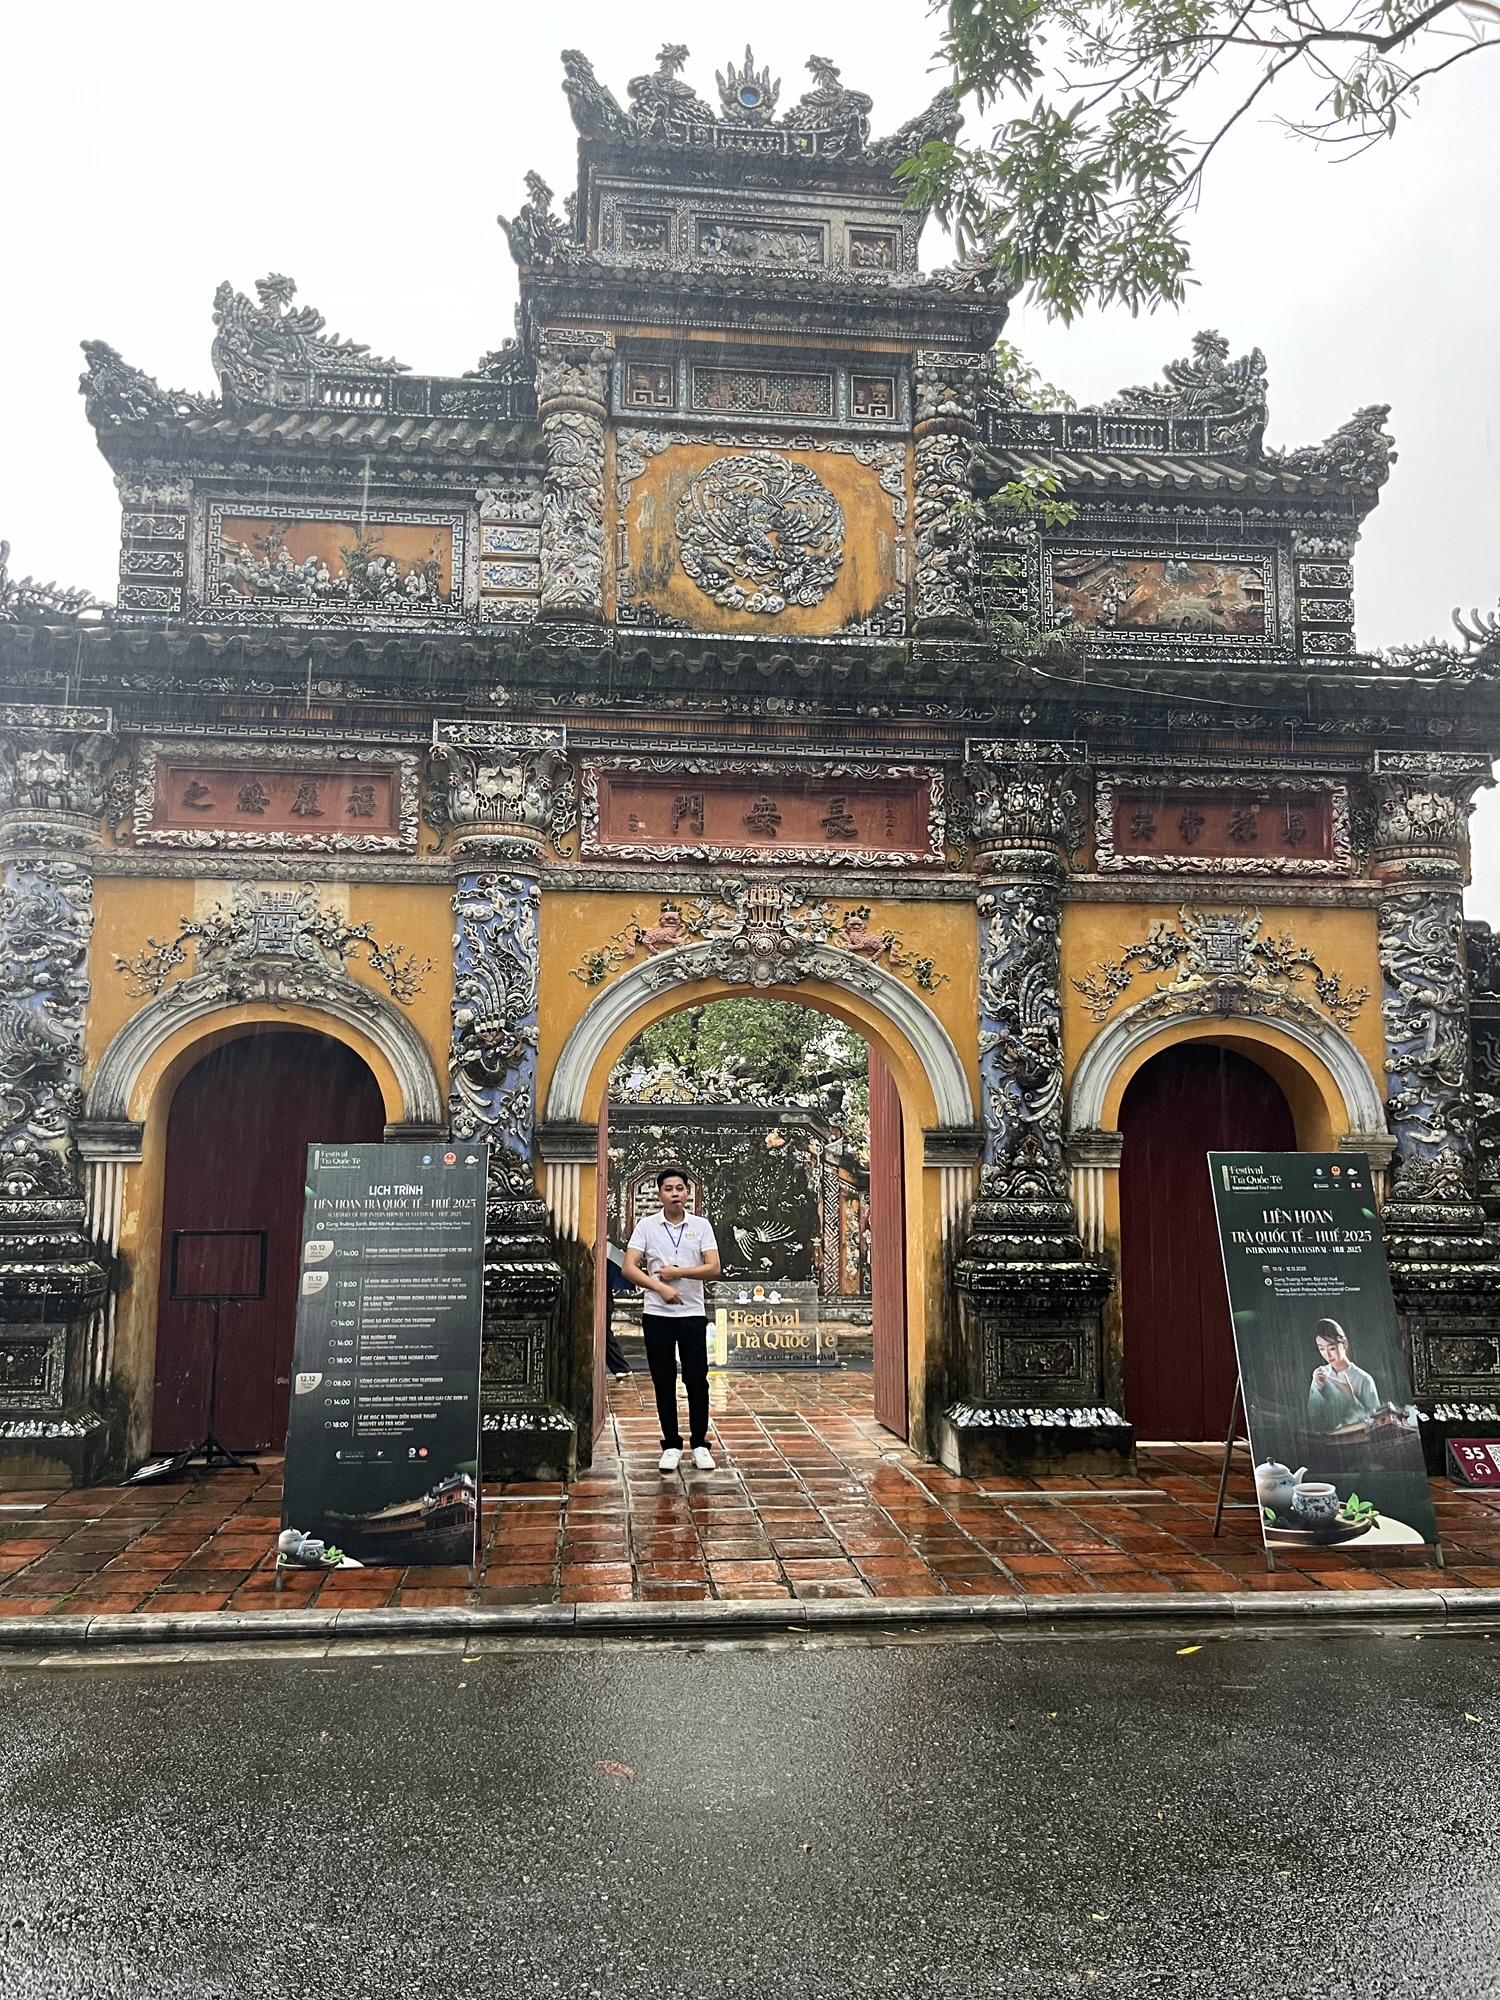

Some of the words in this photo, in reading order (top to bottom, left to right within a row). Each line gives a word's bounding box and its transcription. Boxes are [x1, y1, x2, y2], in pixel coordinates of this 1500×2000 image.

[1229, 1165, 1264, 1174] Festival
[1230, 1175, 1246, 1184] Trà
[1246, 1175, 1270, 1184] Quốc
[1270, 1175, 1282, 1184] Tế
[369, 1185, 391, 1196] LỊCH
[394, 1184, 423, 1195] TRÌNH
[453, 1198, 476, 1208] 2025
[1263, 1208, 1292, 1223] LIÊN
[1294, 1210, 1333, 1223] HOAN
[1230, 1229, 1254, 1243] TRÀ
[1255, 1228, 1289, 1245] QUỐC
[1290, 1228, 1305, 1242] TẾ
[1315, 1227, 1341, 1242] HUẾ
[1342, 1230, 1372, 1242] 2025
[1245, 1246, 1288, 1254] INTERNATIONAL
[730, 1309, 800, 1328] Festival
[732, 1331, 760, 1348] Trà
[1461, 1447, 1485, 1460] 35
